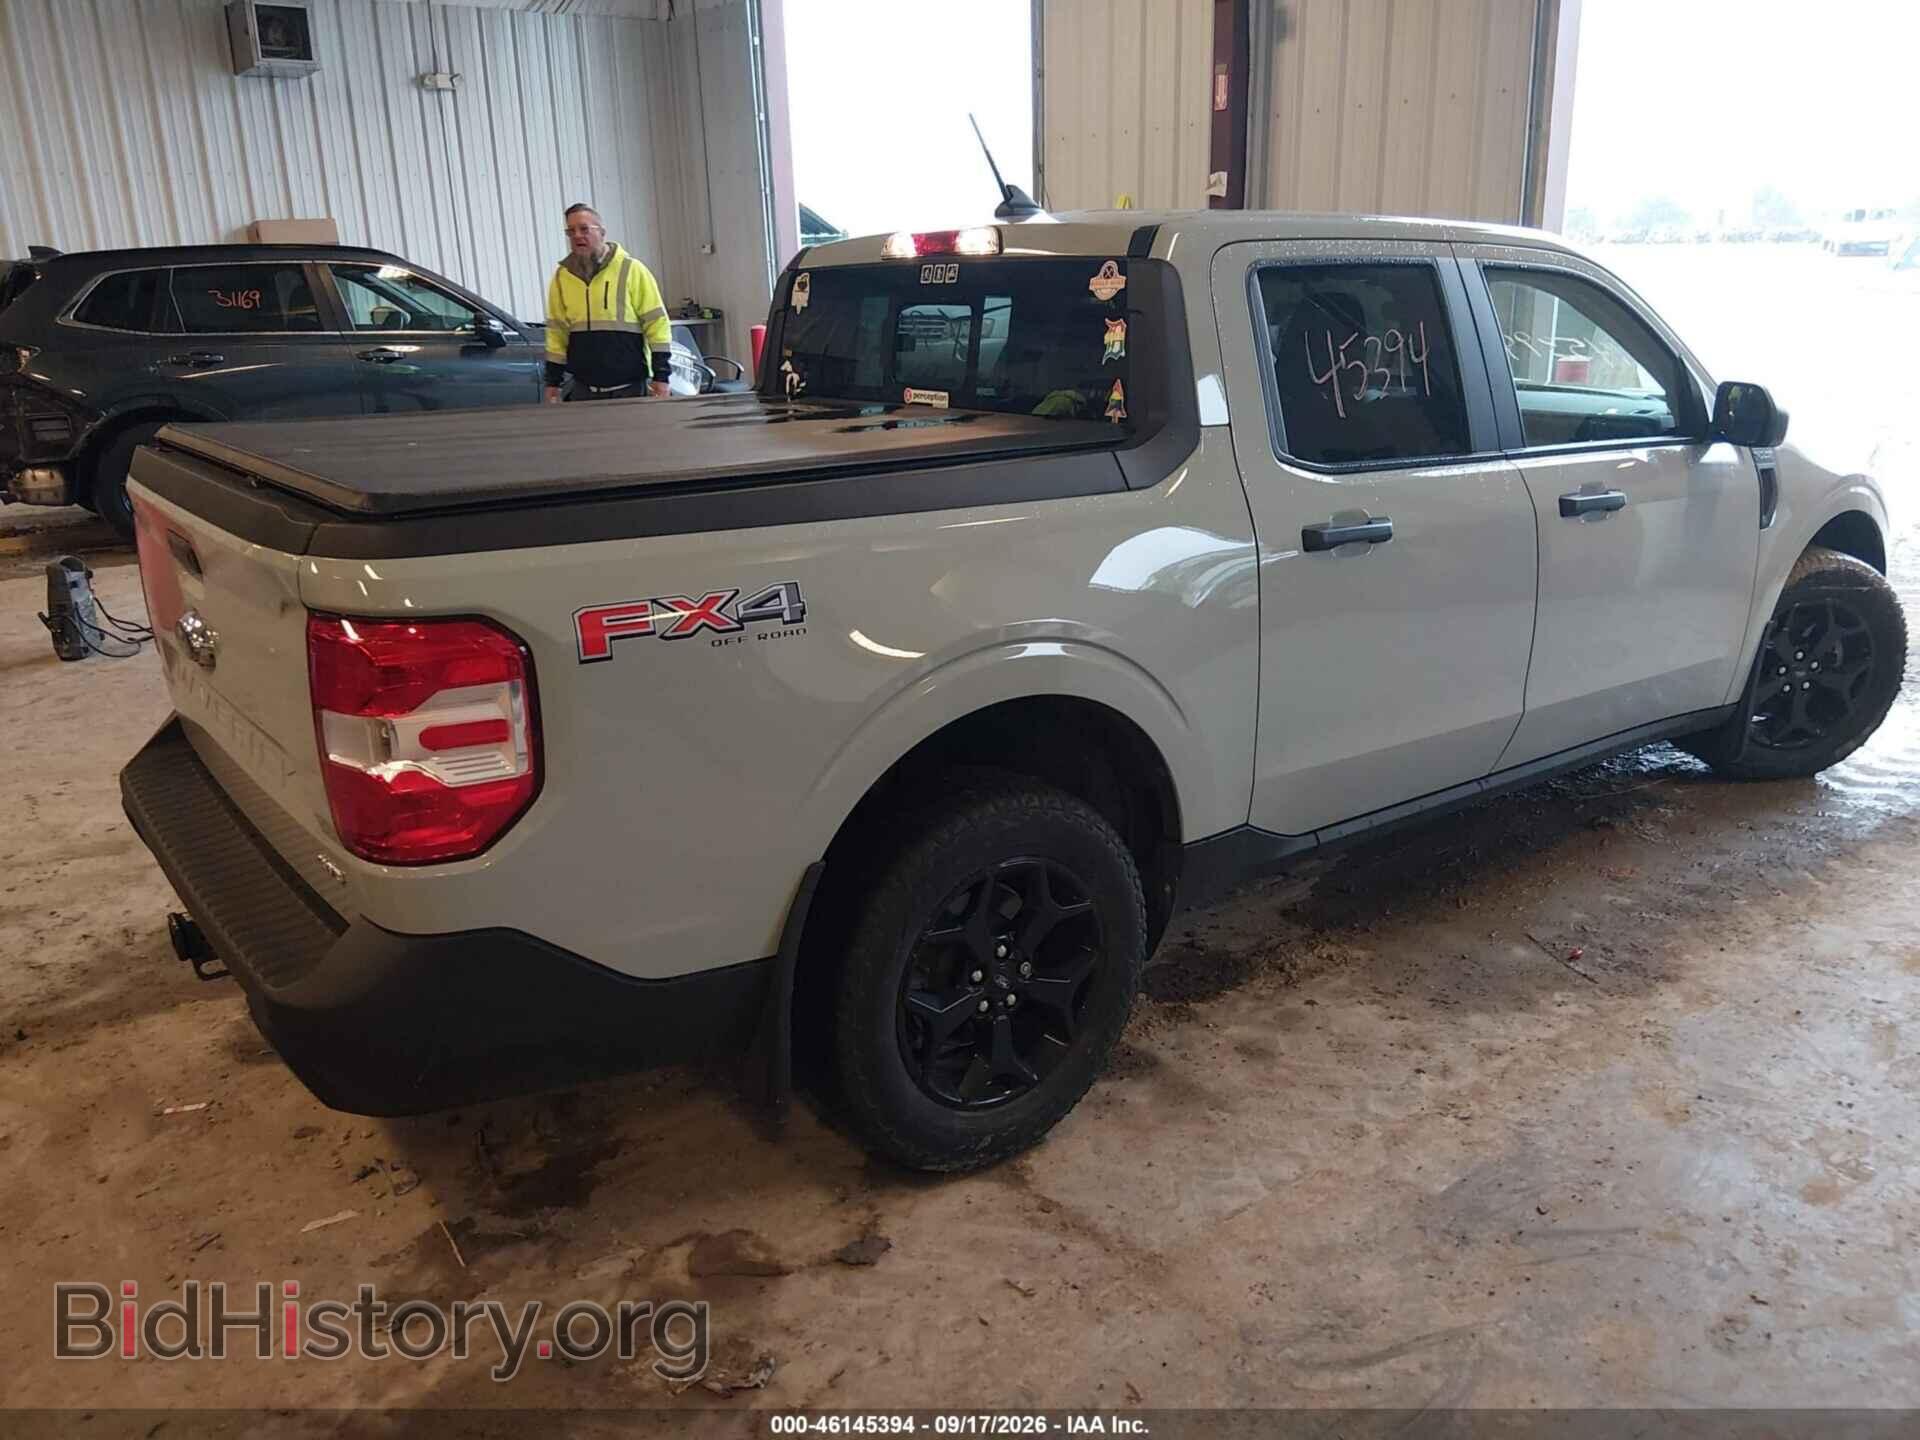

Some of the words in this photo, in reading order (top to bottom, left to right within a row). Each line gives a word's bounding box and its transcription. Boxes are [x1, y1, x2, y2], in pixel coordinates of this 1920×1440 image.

[208, 289, 261, 309] 31169
[1304, 321, 1431, 418] 45394
[572, 581, 808, 664] FX4
[710, 636, 750, 648] OFF
[757, 627, 808, 642] ROAD
